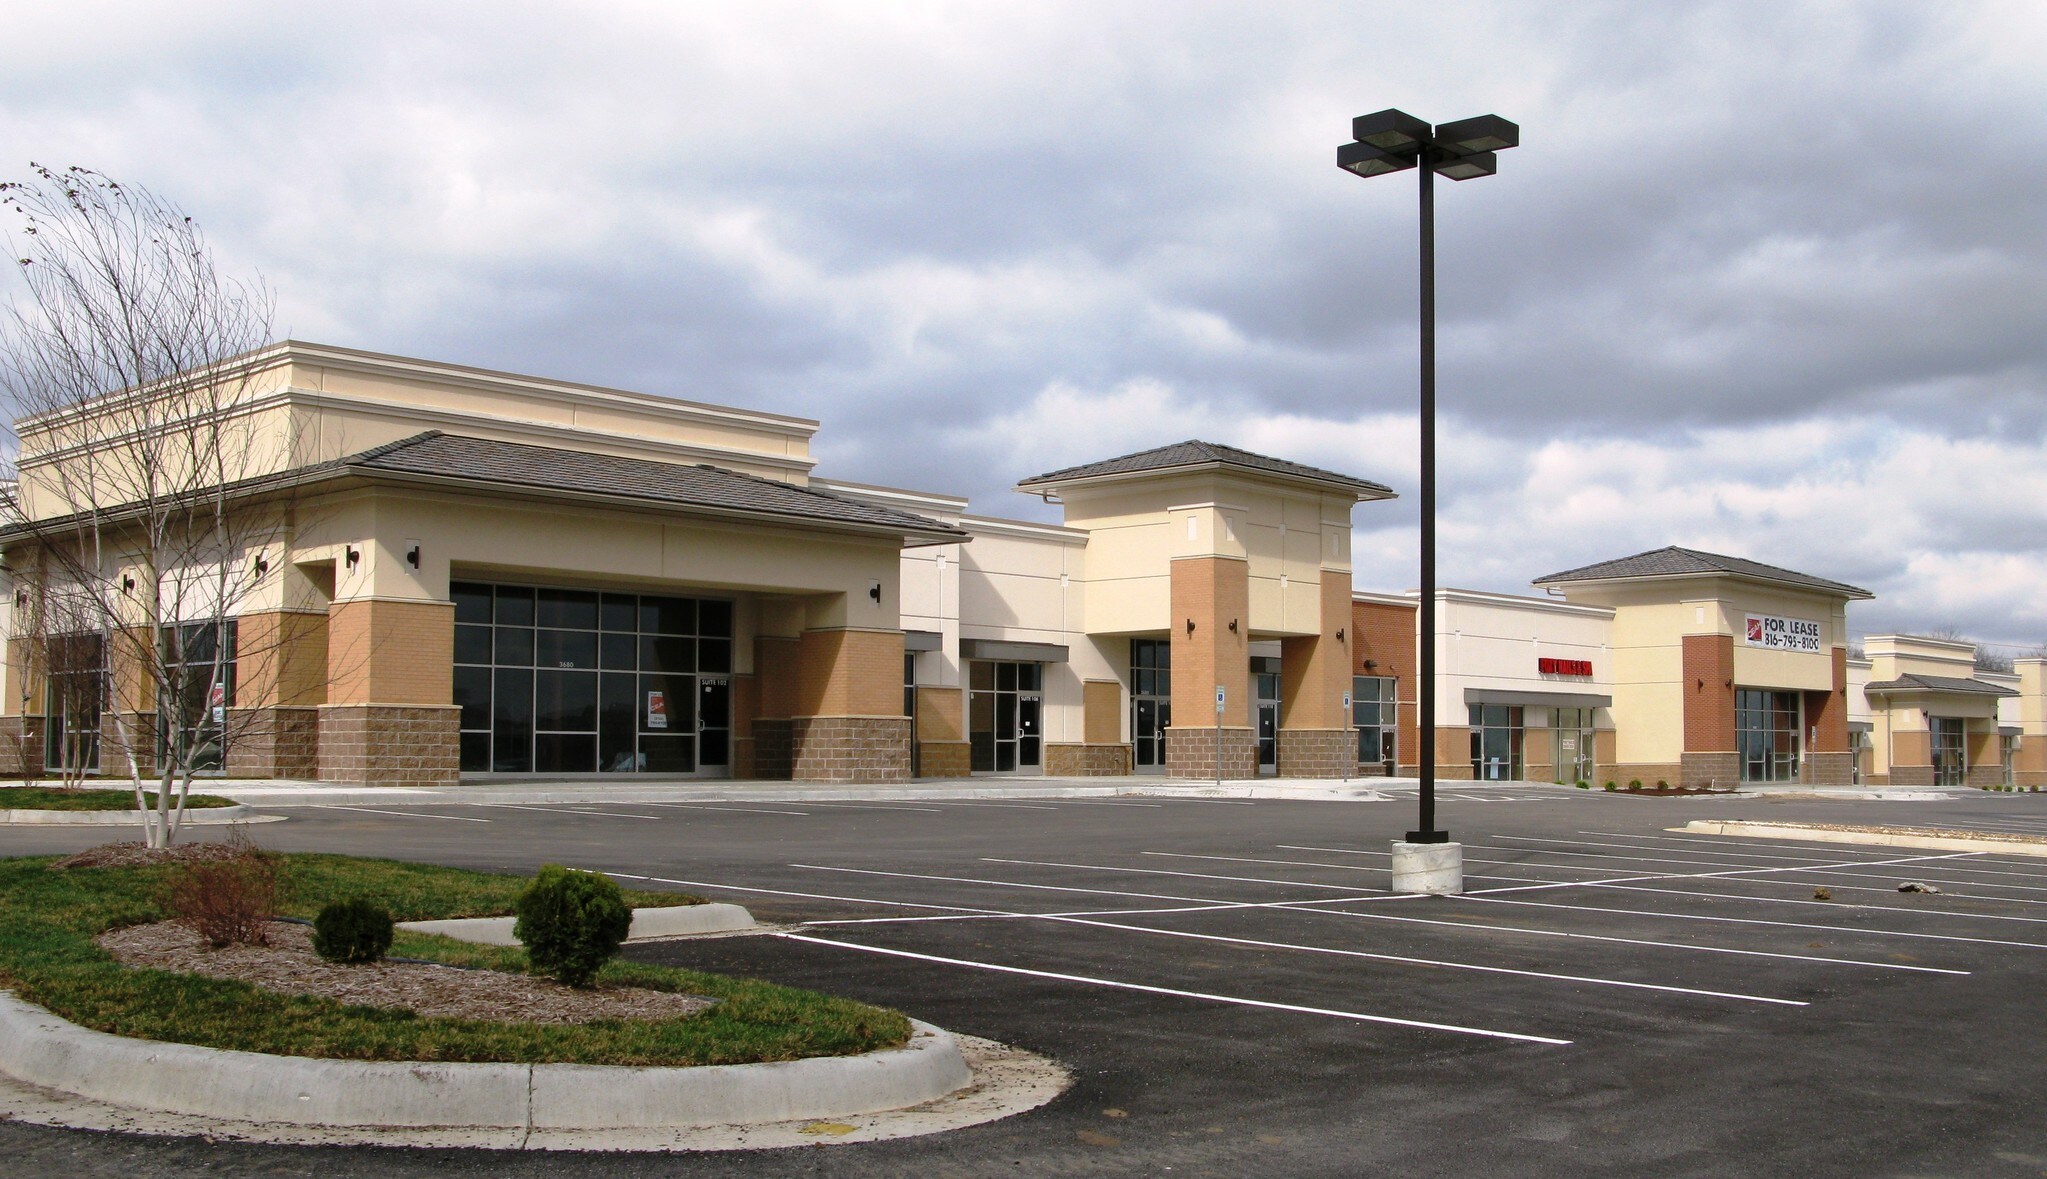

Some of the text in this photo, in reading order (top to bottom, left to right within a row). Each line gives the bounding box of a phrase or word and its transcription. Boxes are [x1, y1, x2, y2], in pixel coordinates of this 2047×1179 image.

[1764, 618, 1786, 633] FOR
[1790, 621, 1819, 637] LEASE
[1764, 633, 1819, 650] 816-795-8100
